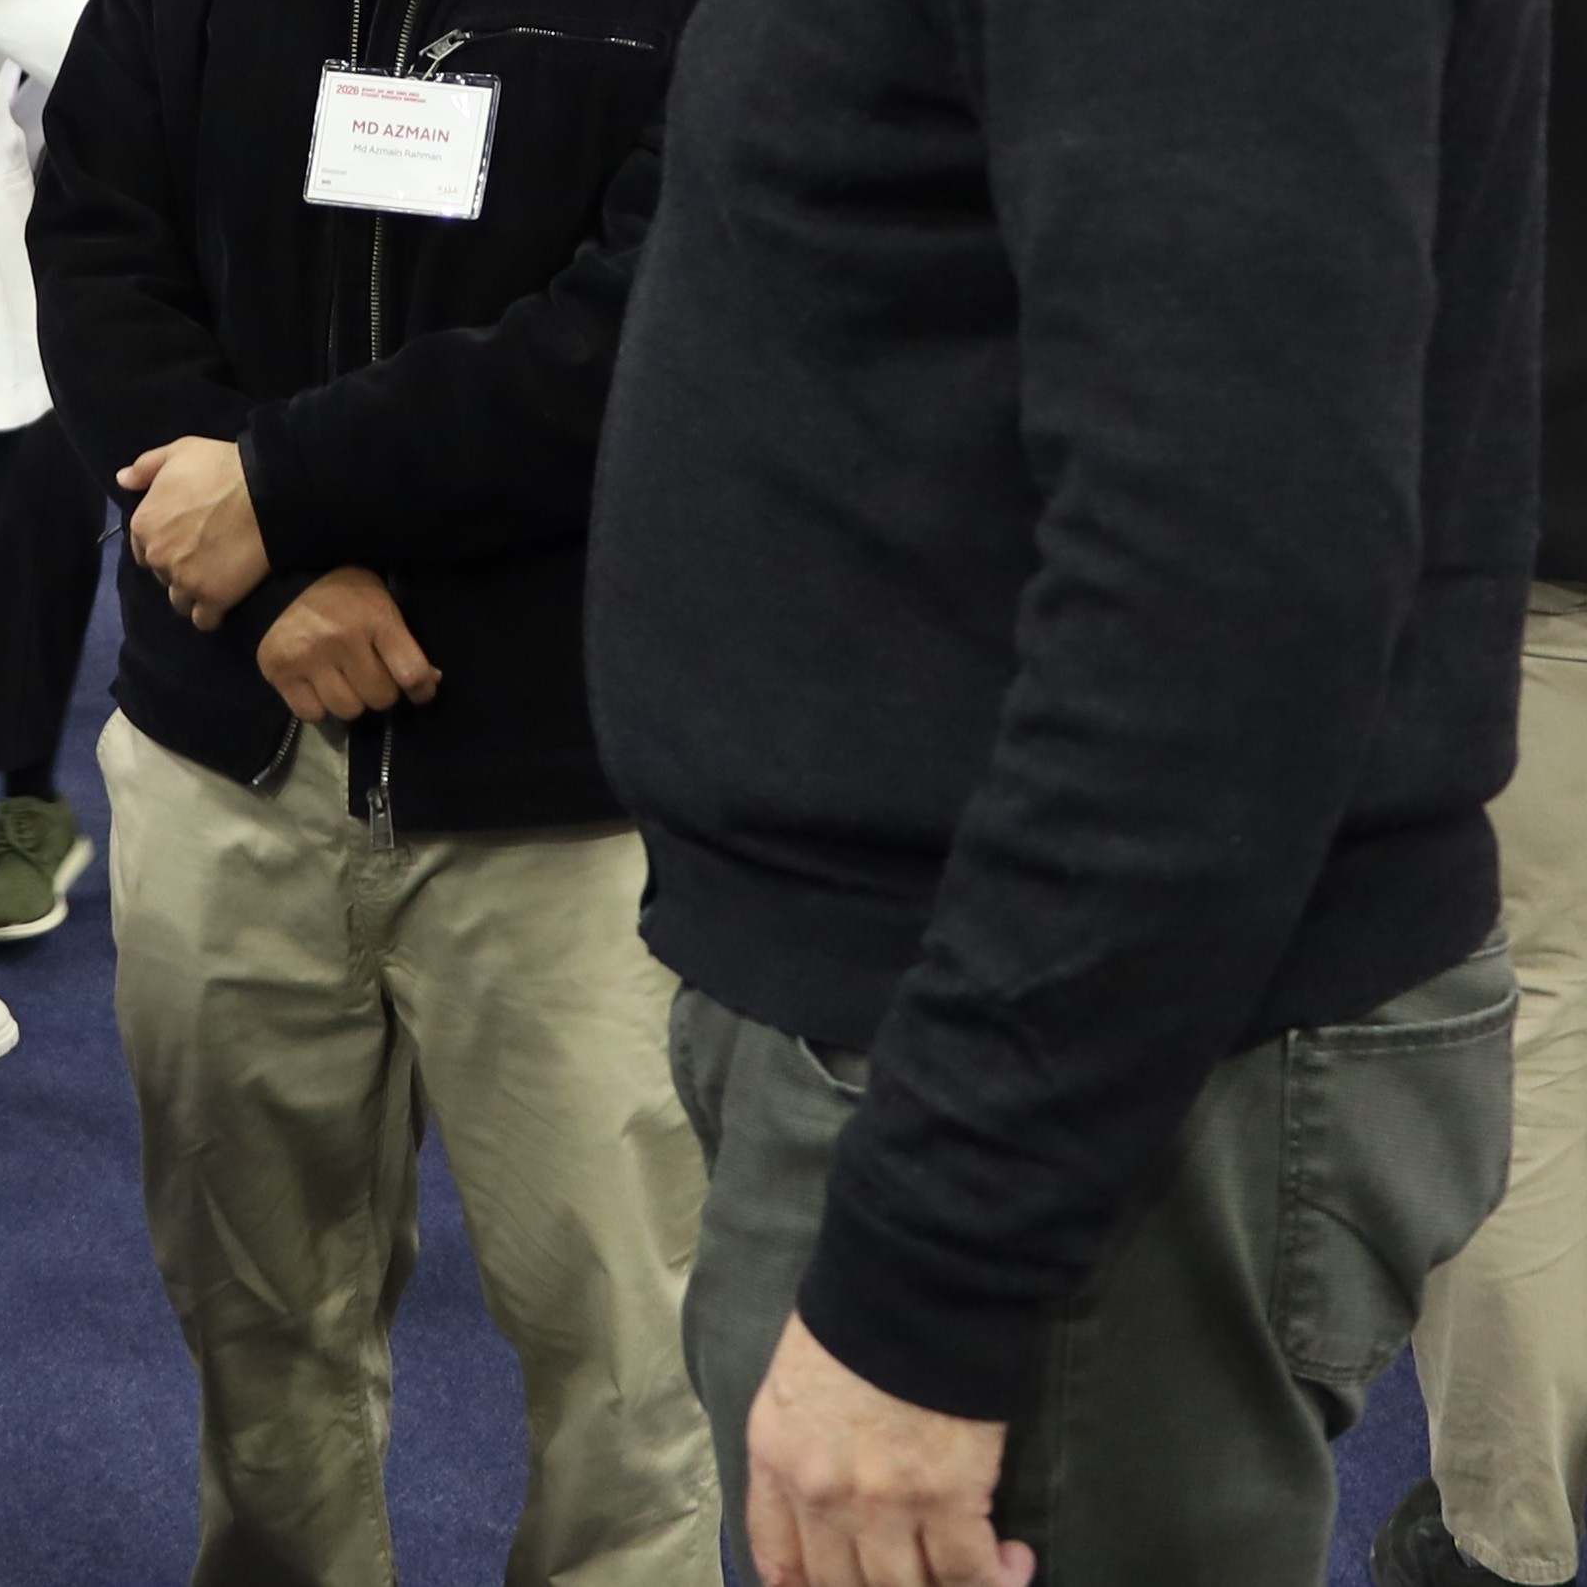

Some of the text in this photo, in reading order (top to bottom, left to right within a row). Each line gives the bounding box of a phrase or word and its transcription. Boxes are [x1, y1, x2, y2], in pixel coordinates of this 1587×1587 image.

[351, 120, 450, 143] MD AZMAIN
[353, 143, 442, 161] Md Azmain Rahman
